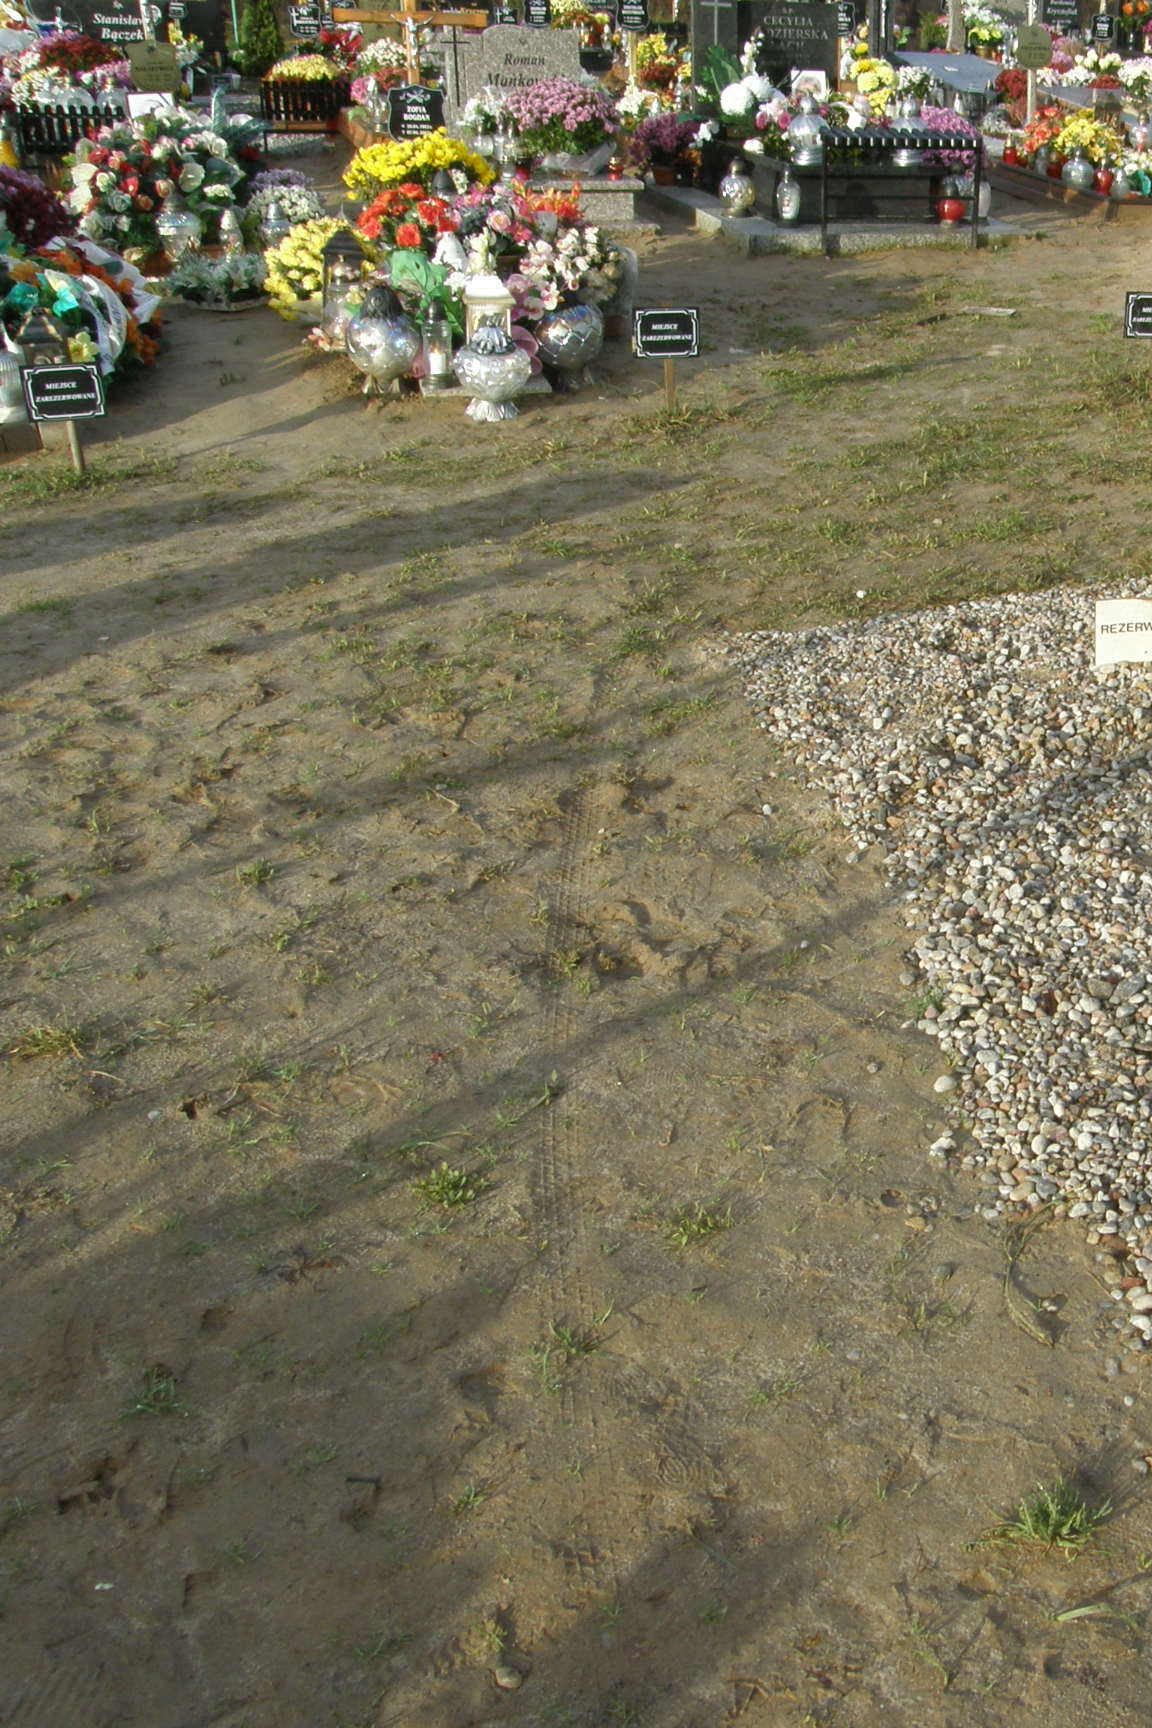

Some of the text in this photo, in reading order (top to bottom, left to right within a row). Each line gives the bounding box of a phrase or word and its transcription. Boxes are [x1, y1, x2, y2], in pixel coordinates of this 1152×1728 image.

[763, 16, 813, 27] CECYLIA
[101, 28, 145, 41] Bączek
[503, 53, 545, 66] Roman
[406, 106, 427, 114] ZOFIA
[641, 334, 692, 342] ZAREZERWOWANE
[45, 382, 77, 390] MIEJSCE
[36, 393, 96, 403] ZAREZERWOWANE
